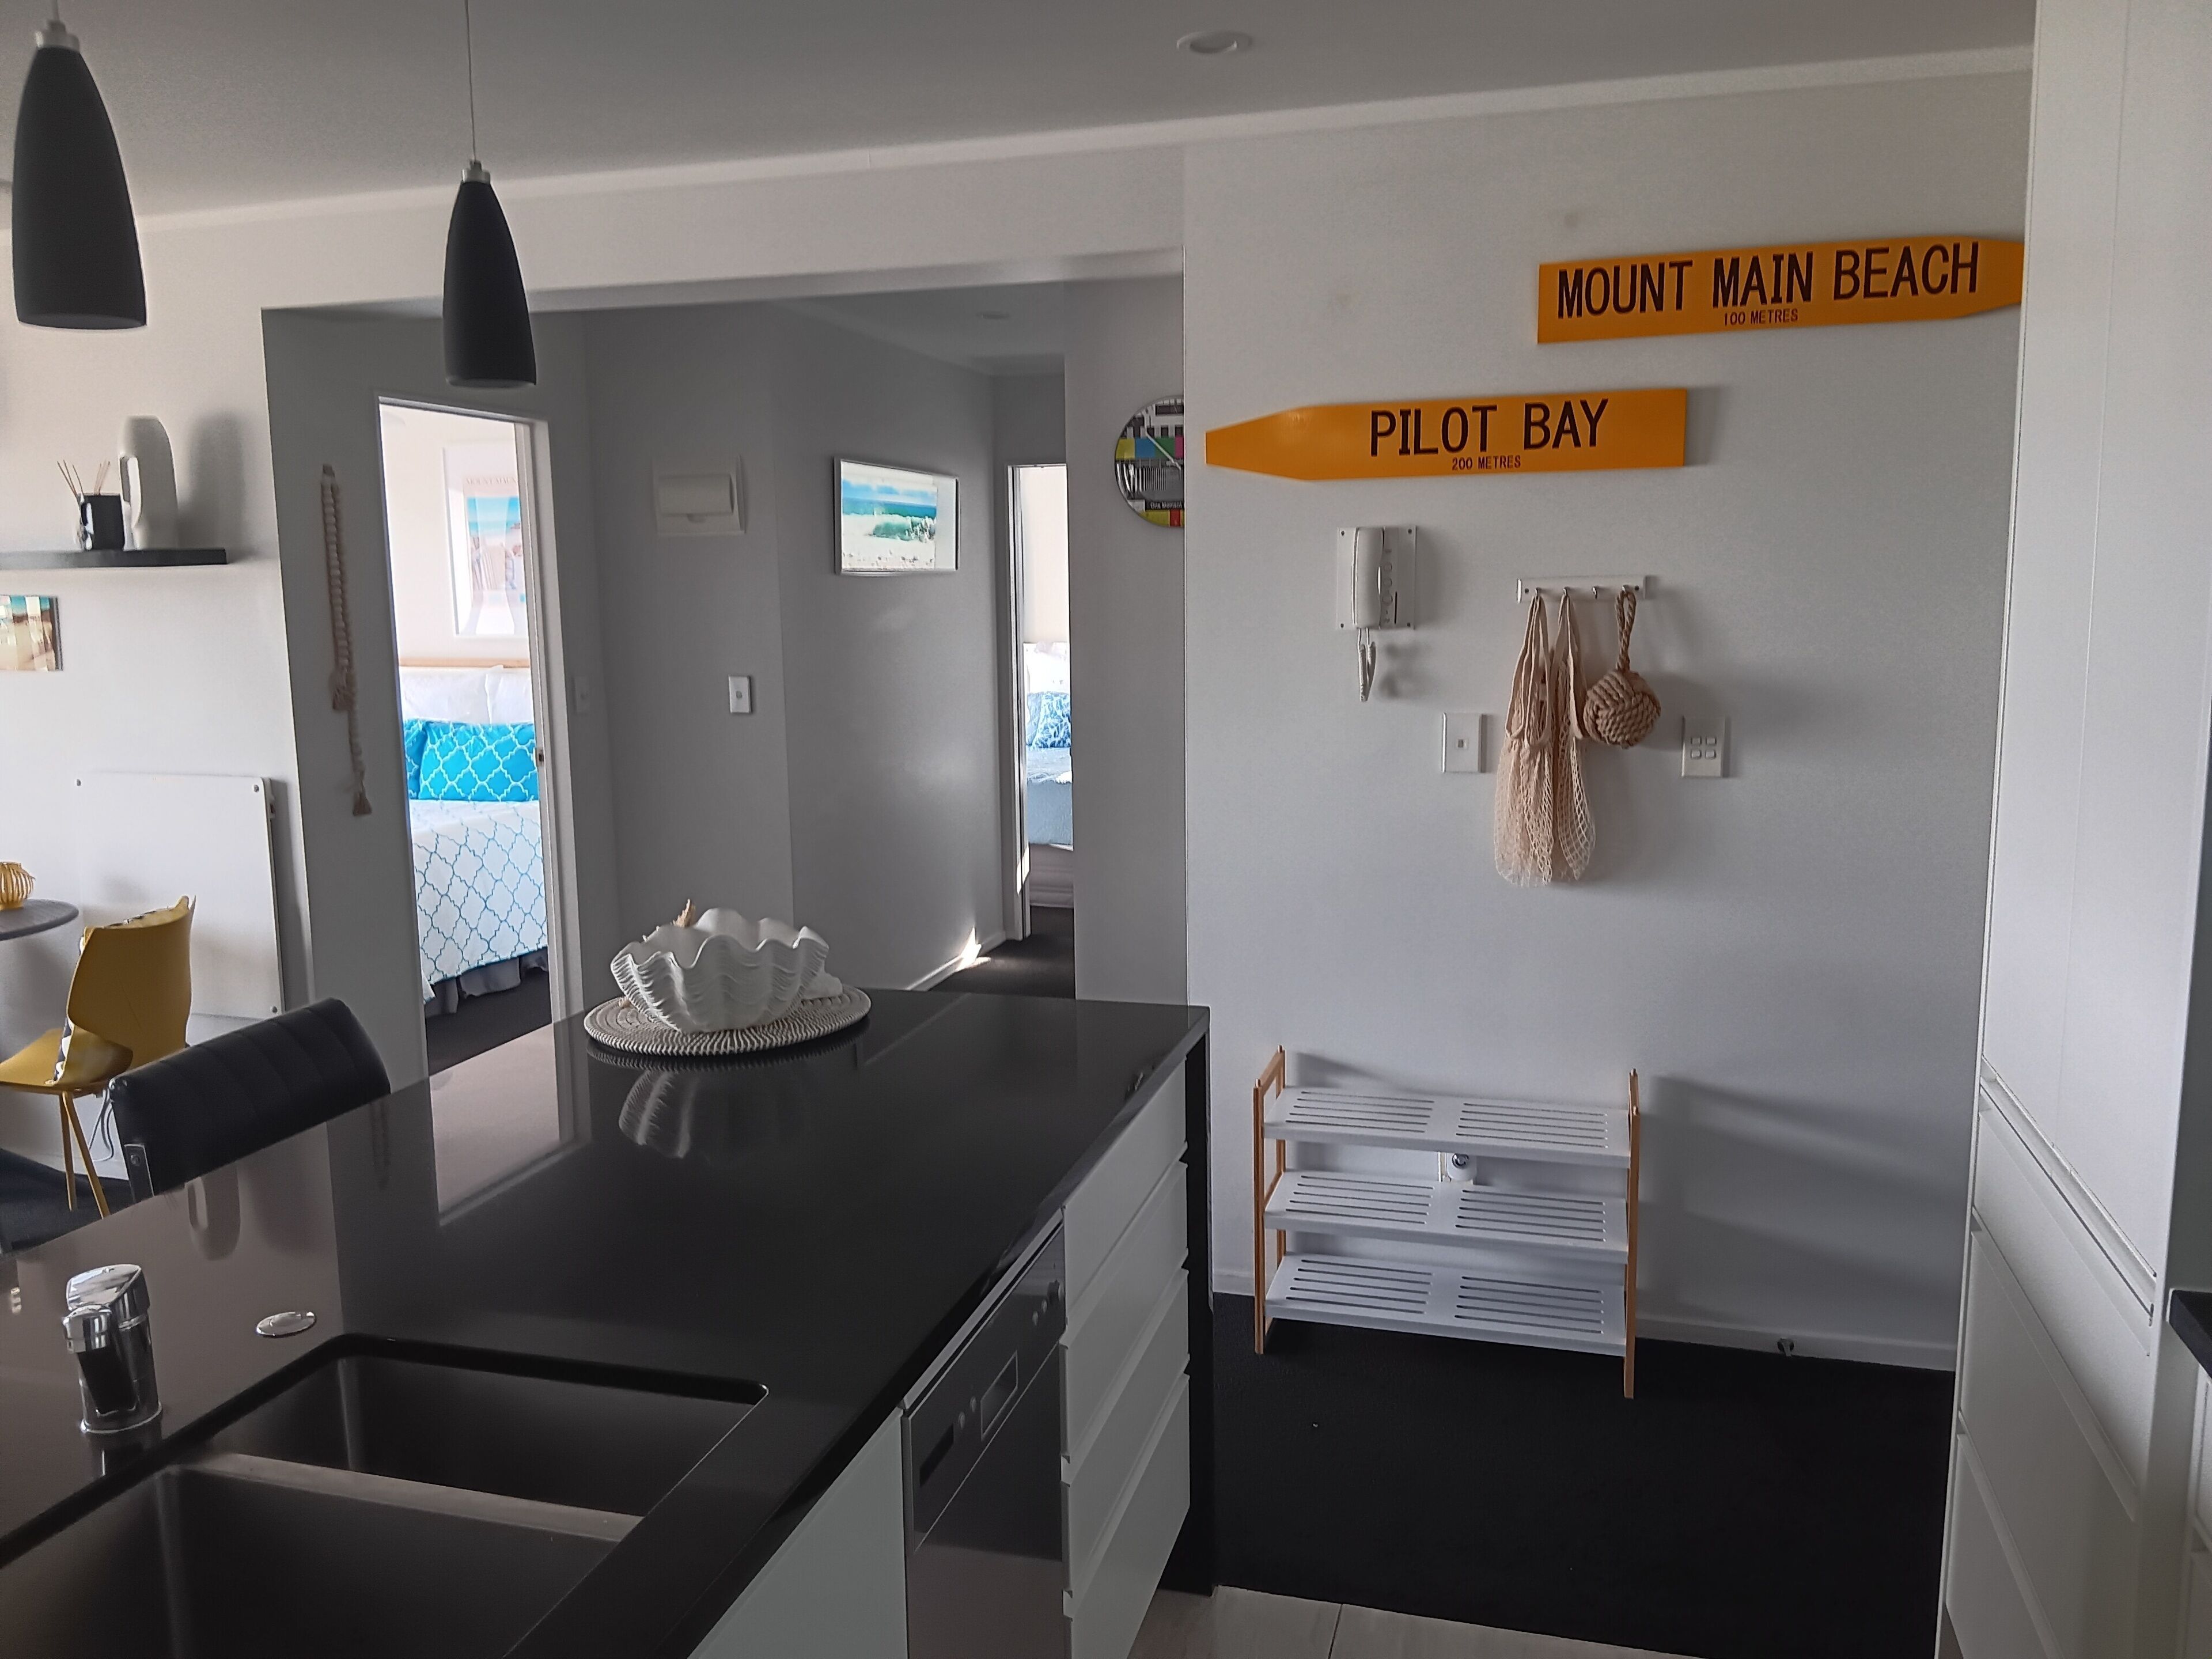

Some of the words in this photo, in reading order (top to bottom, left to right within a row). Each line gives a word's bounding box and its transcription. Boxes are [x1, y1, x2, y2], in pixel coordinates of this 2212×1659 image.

[1558, 260, 1693, 319] MOUNT
[1713, 251, 1813, 308] MAIN
[1834, 241, 1979, 301] BEACH
[1724, 312, 1746, 326] 100
[1750, 308, 1798, 324] METRES
[1370, 404, 1498, 457] PILOT
[1524, 399, 1608, 449] BAY
[1452, 457, 1473, 471] 200
[1478, 454, 1521, 469] METRES
